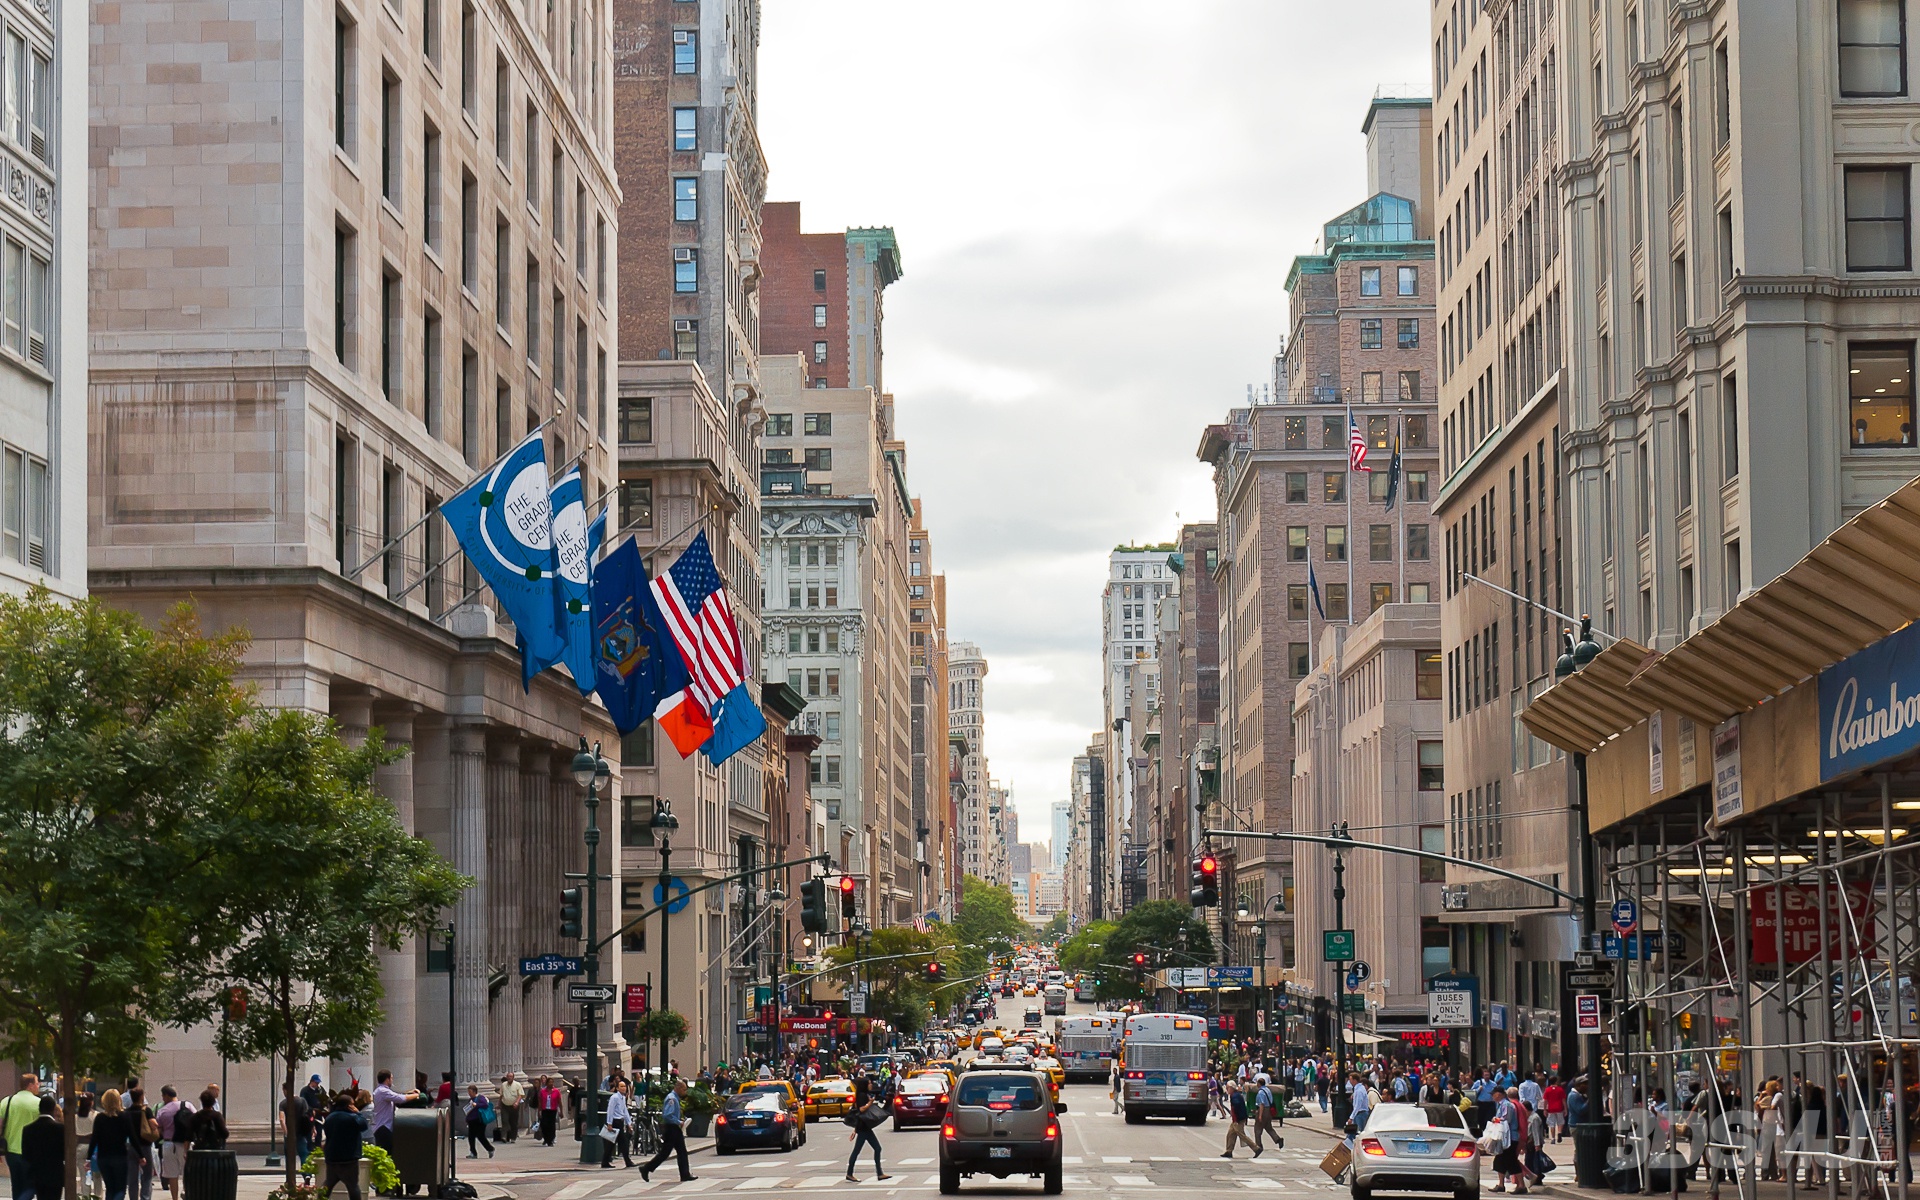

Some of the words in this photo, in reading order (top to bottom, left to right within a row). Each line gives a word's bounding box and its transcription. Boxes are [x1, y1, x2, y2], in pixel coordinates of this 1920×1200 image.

[506, 492, 532, 517] THE
[556, 528, 574, 548] HE
[1765, 889, 1862, 911] BEADS
[1798, 916, 1815, 925] On
[525, 961, 545, 971] East
[547, 961, 564, 971] 35th
[566, 961, 576, 971] St
[1434, 980, 1460, 988] Empire
[1575, 976, 1590, 984] ONE
[1597, 976, 1613, 984] WAY
[1437, 993, 1464, 1002] BUSES
